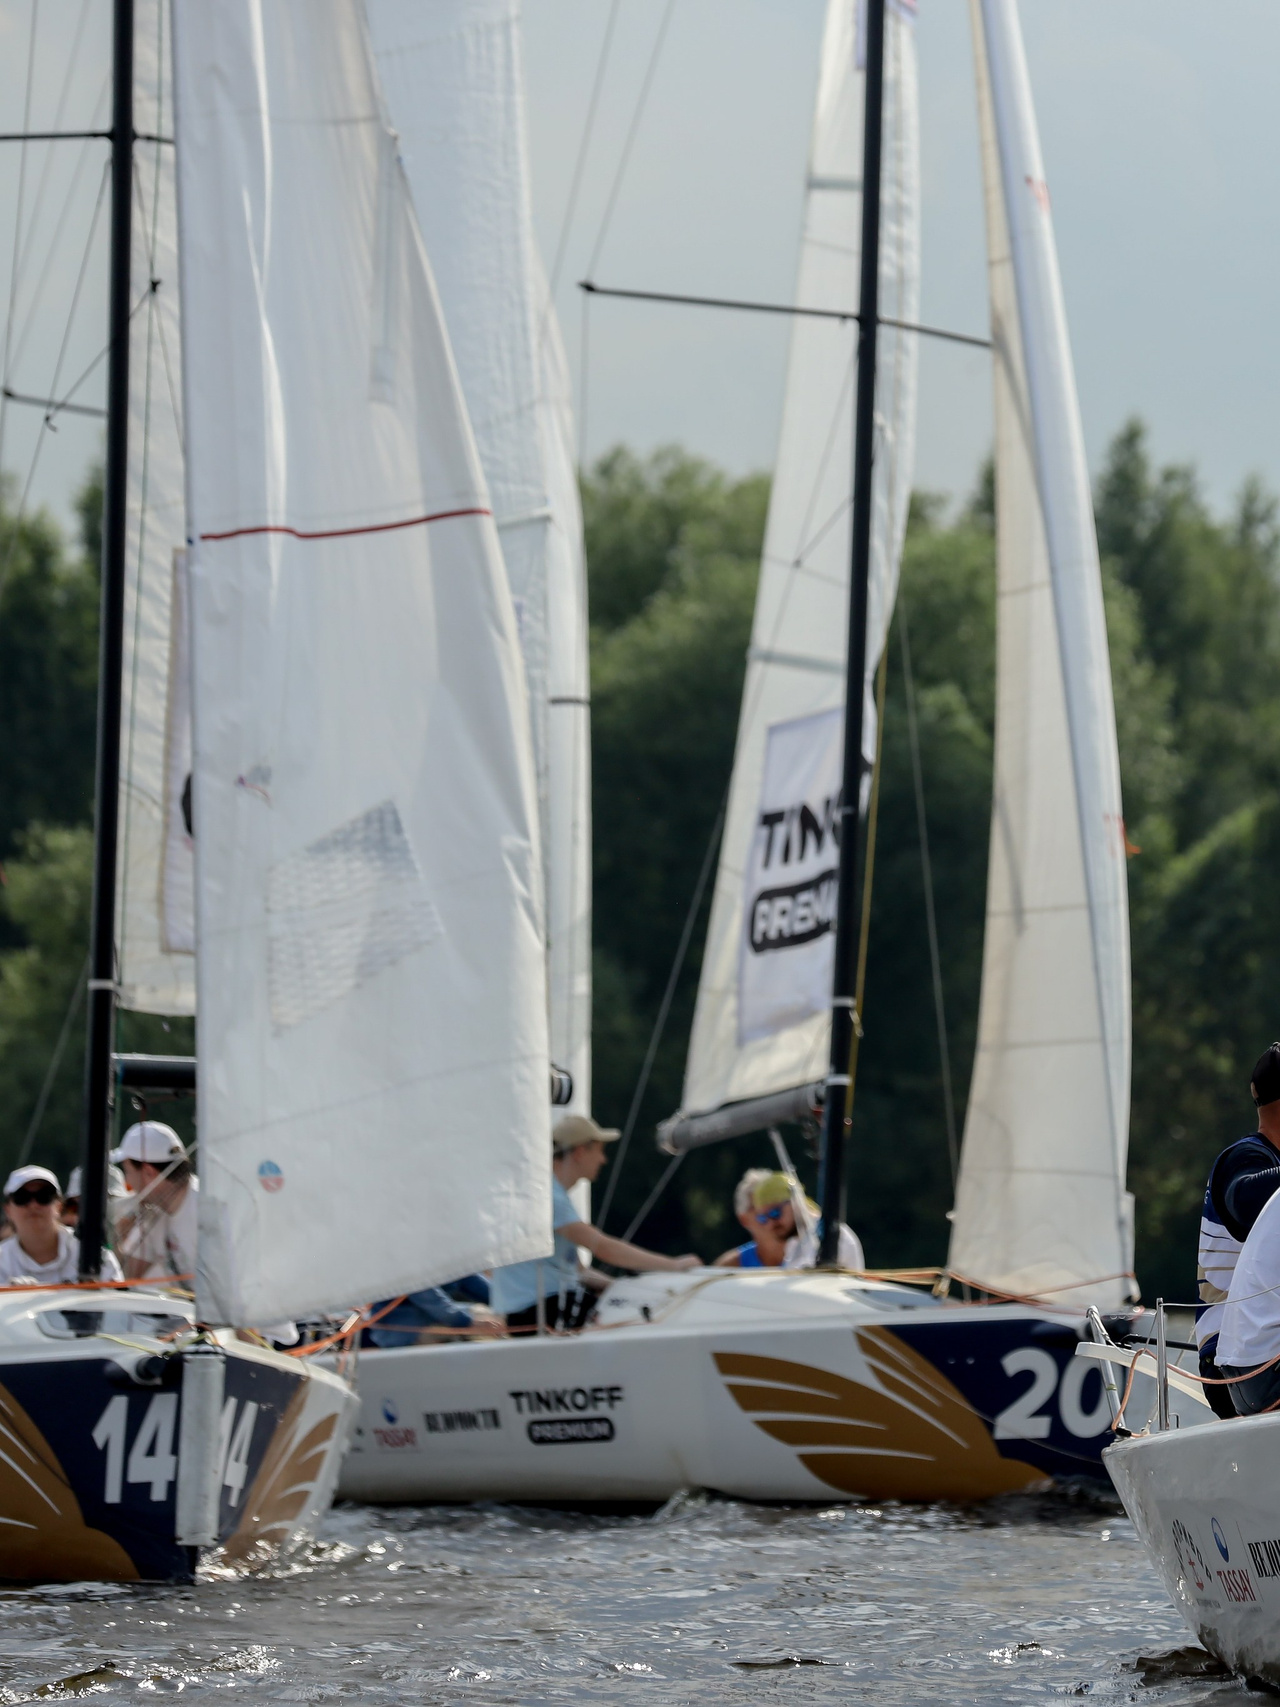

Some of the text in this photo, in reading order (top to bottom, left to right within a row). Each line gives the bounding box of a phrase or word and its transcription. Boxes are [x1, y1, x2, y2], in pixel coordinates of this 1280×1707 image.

[508, 1386, 624, 1415] TINKOFF
[993, 1346, 1123, 1441] 20
[91, 1392, 179, 1504] 14
[1216, 1569, 1257, 1602] TASSAY
